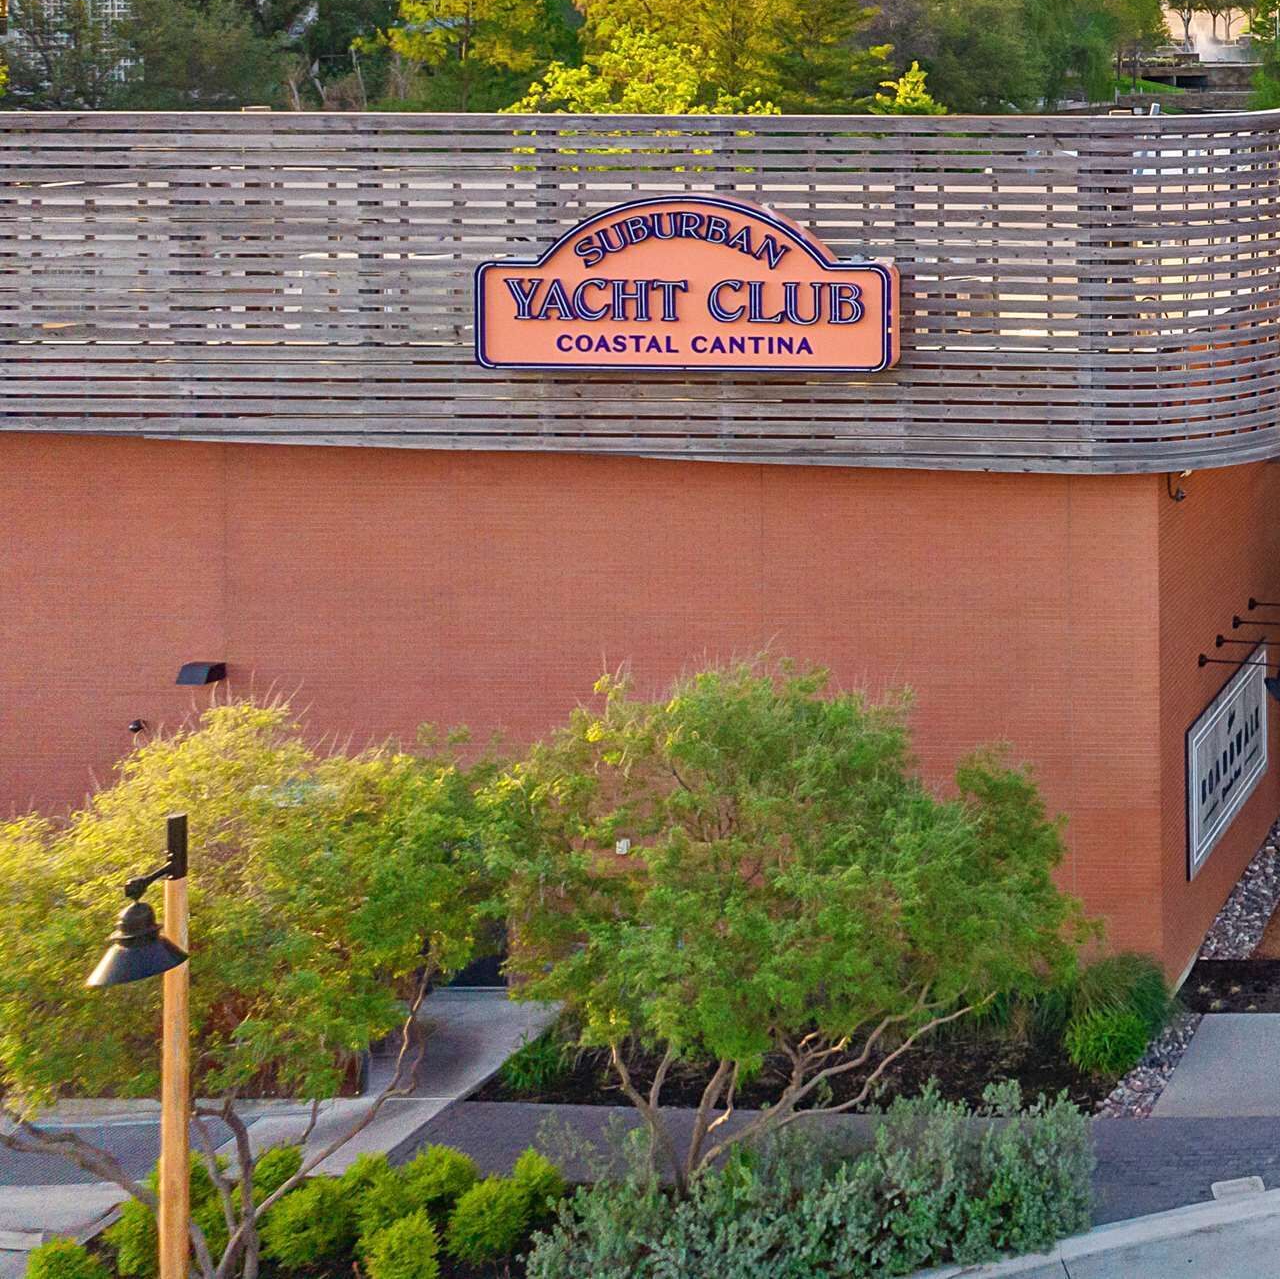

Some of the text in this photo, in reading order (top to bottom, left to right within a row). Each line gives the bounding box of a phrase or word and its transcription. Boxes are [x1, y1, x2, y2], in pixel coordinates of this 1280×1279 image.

[574, 211, 791, 269] SUBURBAN
[502, 277, 866, 325] YACHT CLUB
[556, 334, 814, 355] COASTAL CANTINA
